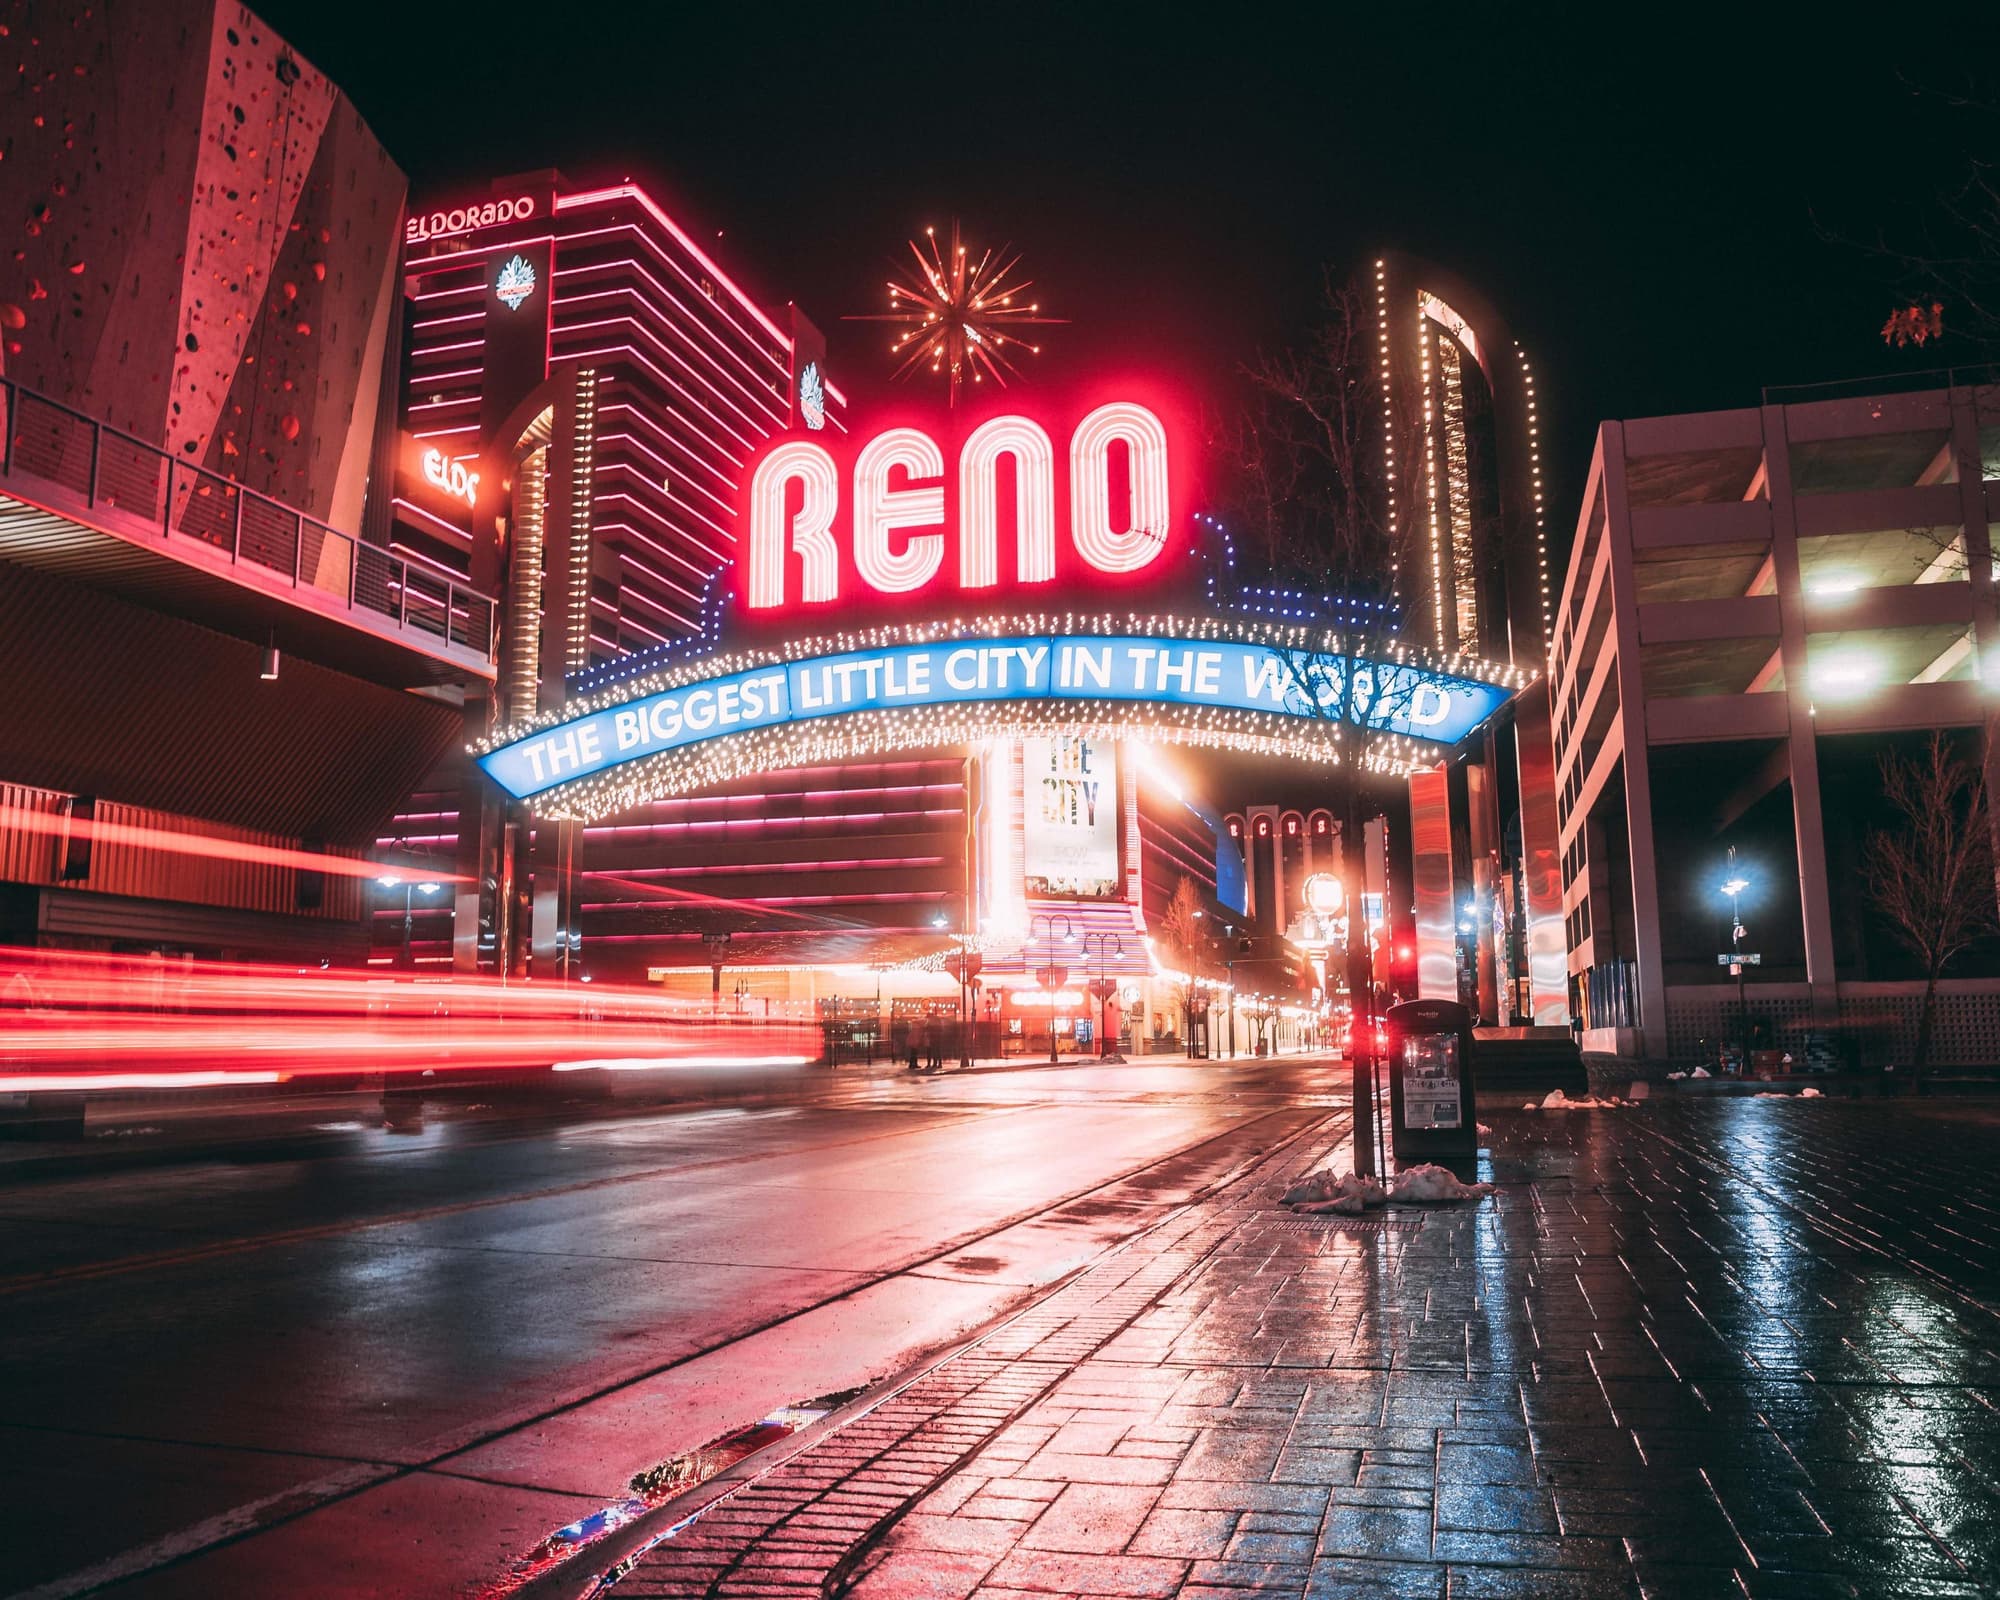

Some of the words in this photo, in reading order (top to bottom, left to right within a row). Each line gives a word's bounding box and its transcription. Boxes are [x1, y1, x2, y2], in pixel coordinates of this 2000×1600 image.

[748, 402, 1169, 608] RENO
[523, 725, 602, 783] THE
[615, 675, 786, 750] BIGGEST
[801, 654, 930, 709] LITTLE
[944, 646, 1048, 693] CITY
[1059, 646, 1113, 689] IN
[1128, 650, 1222, 693] THE
[1242, 655, 1451, 726] WORLD
[1042, 777, 1099, 826] CITY
